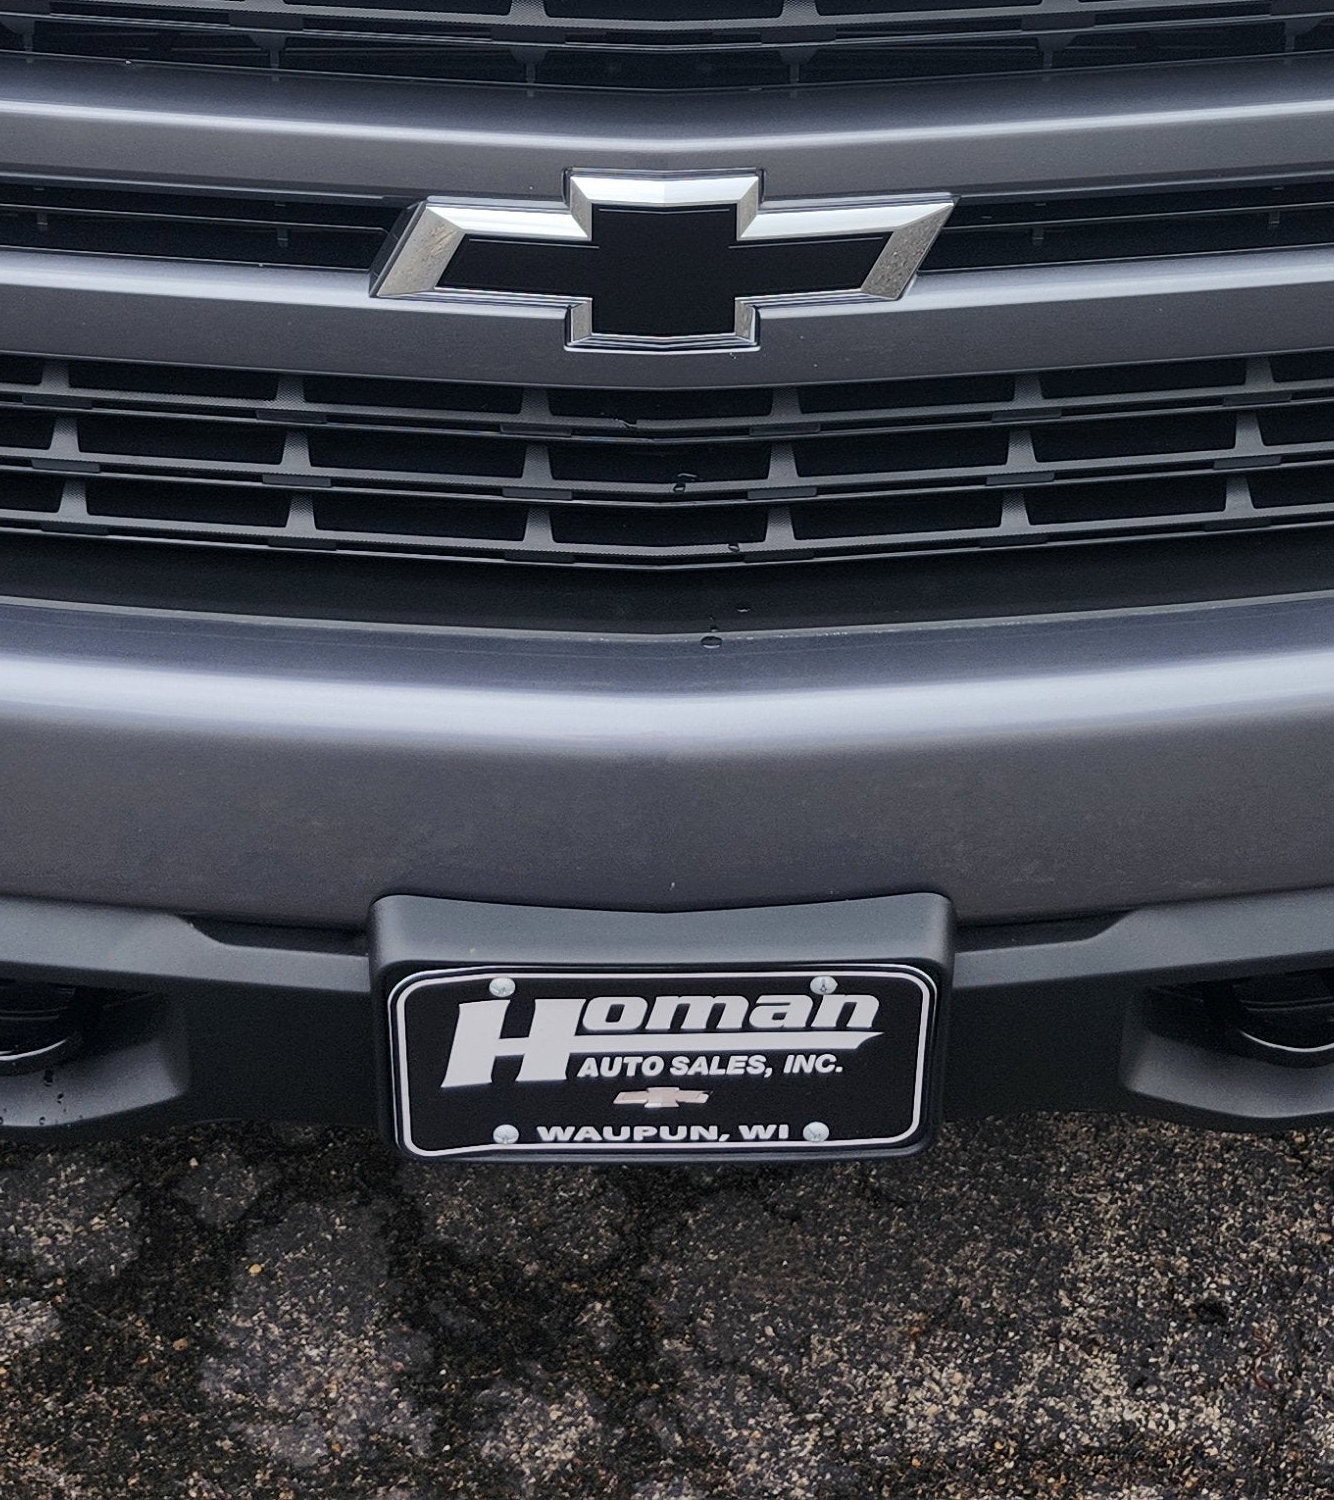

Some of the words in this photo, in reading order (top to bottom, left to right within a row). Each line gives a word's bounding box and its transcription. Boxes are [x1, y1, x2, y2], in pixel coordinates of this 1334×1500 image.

[577, 1055, 665, 1078] AUTO
[669, 1054, 773, 1077] SALES,
[782, 1053, 844, 1074] INC.
[536, 1123, 731, 1143] WAUPUN,
[737, 1124, 790, 1141] WI
